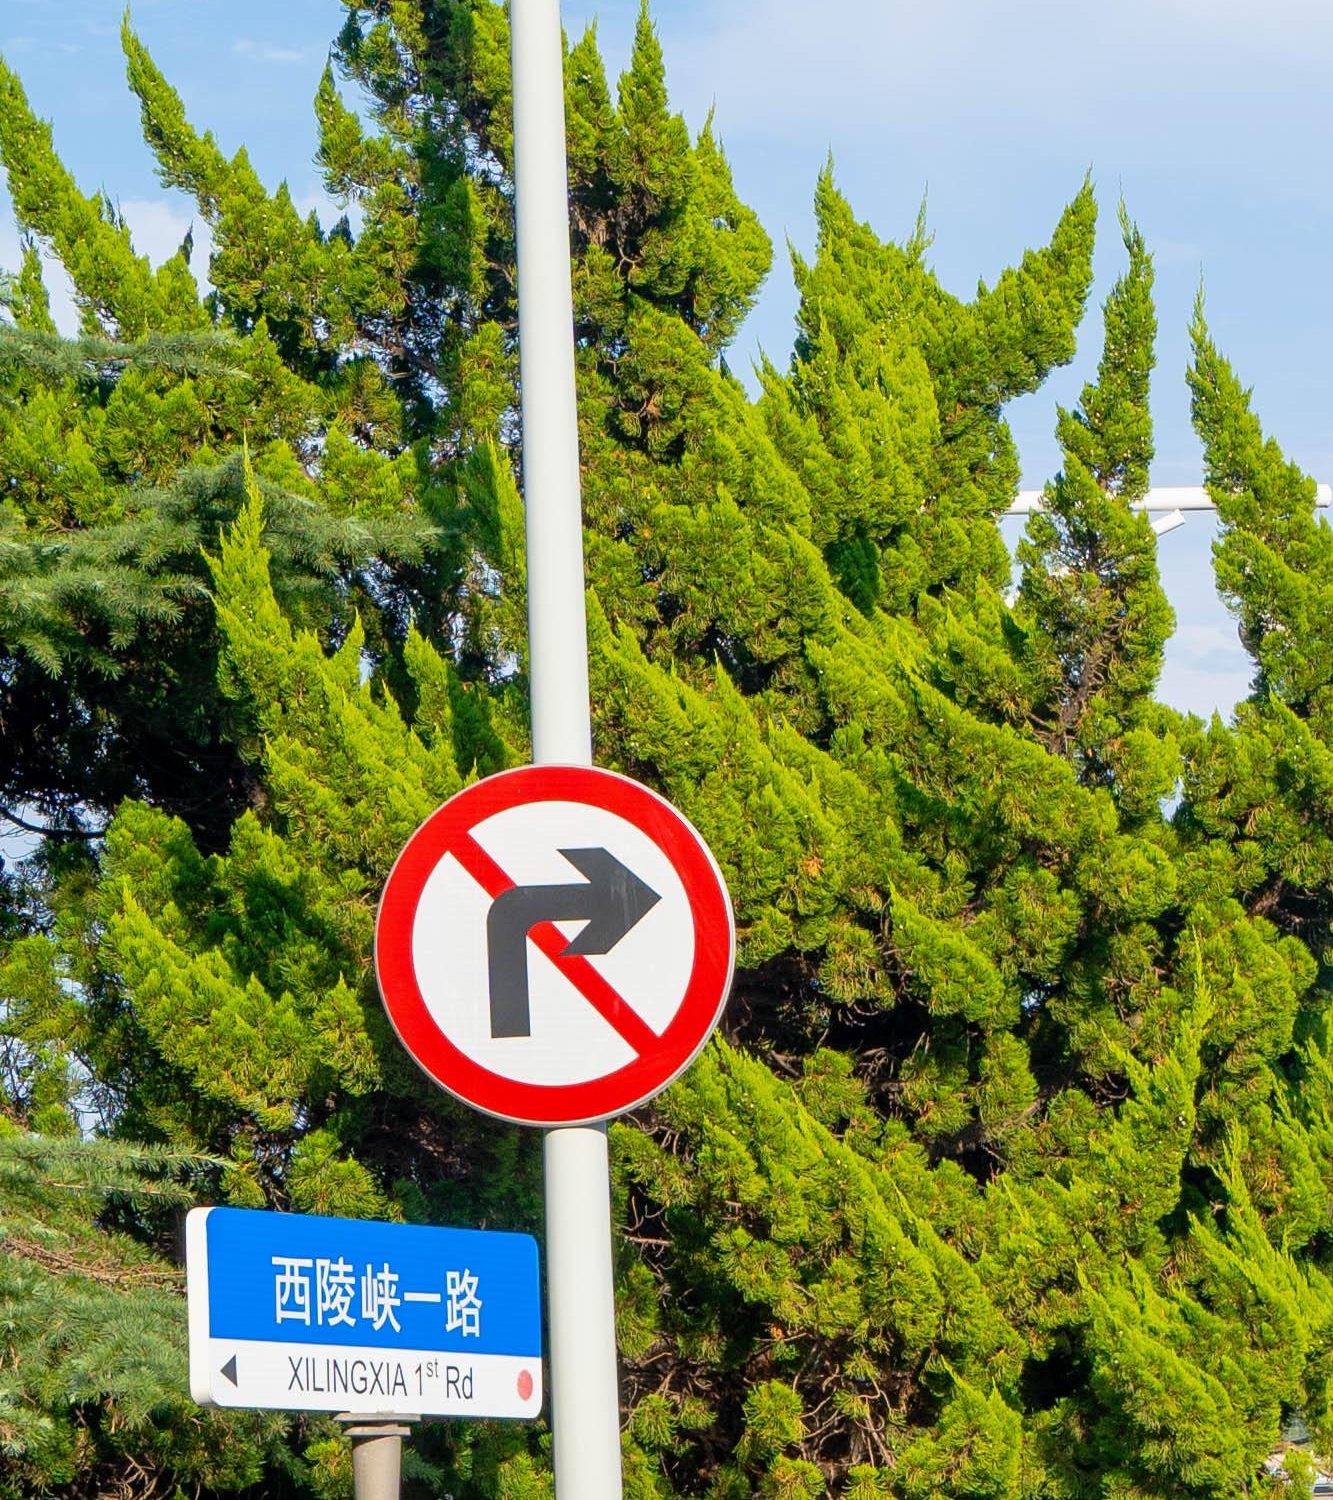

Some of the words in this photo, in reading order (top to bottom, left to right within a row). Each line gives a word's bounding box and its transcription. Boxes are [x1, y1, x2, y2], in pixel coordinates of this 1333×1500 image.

[271, 1255, 483, 1338] 西陵峡一路
[288, 1356, 408, 1397] XILINGXIA
[415, 1358, 440, 1397] 1st
[446, 1365, 474, 1400] Rd
